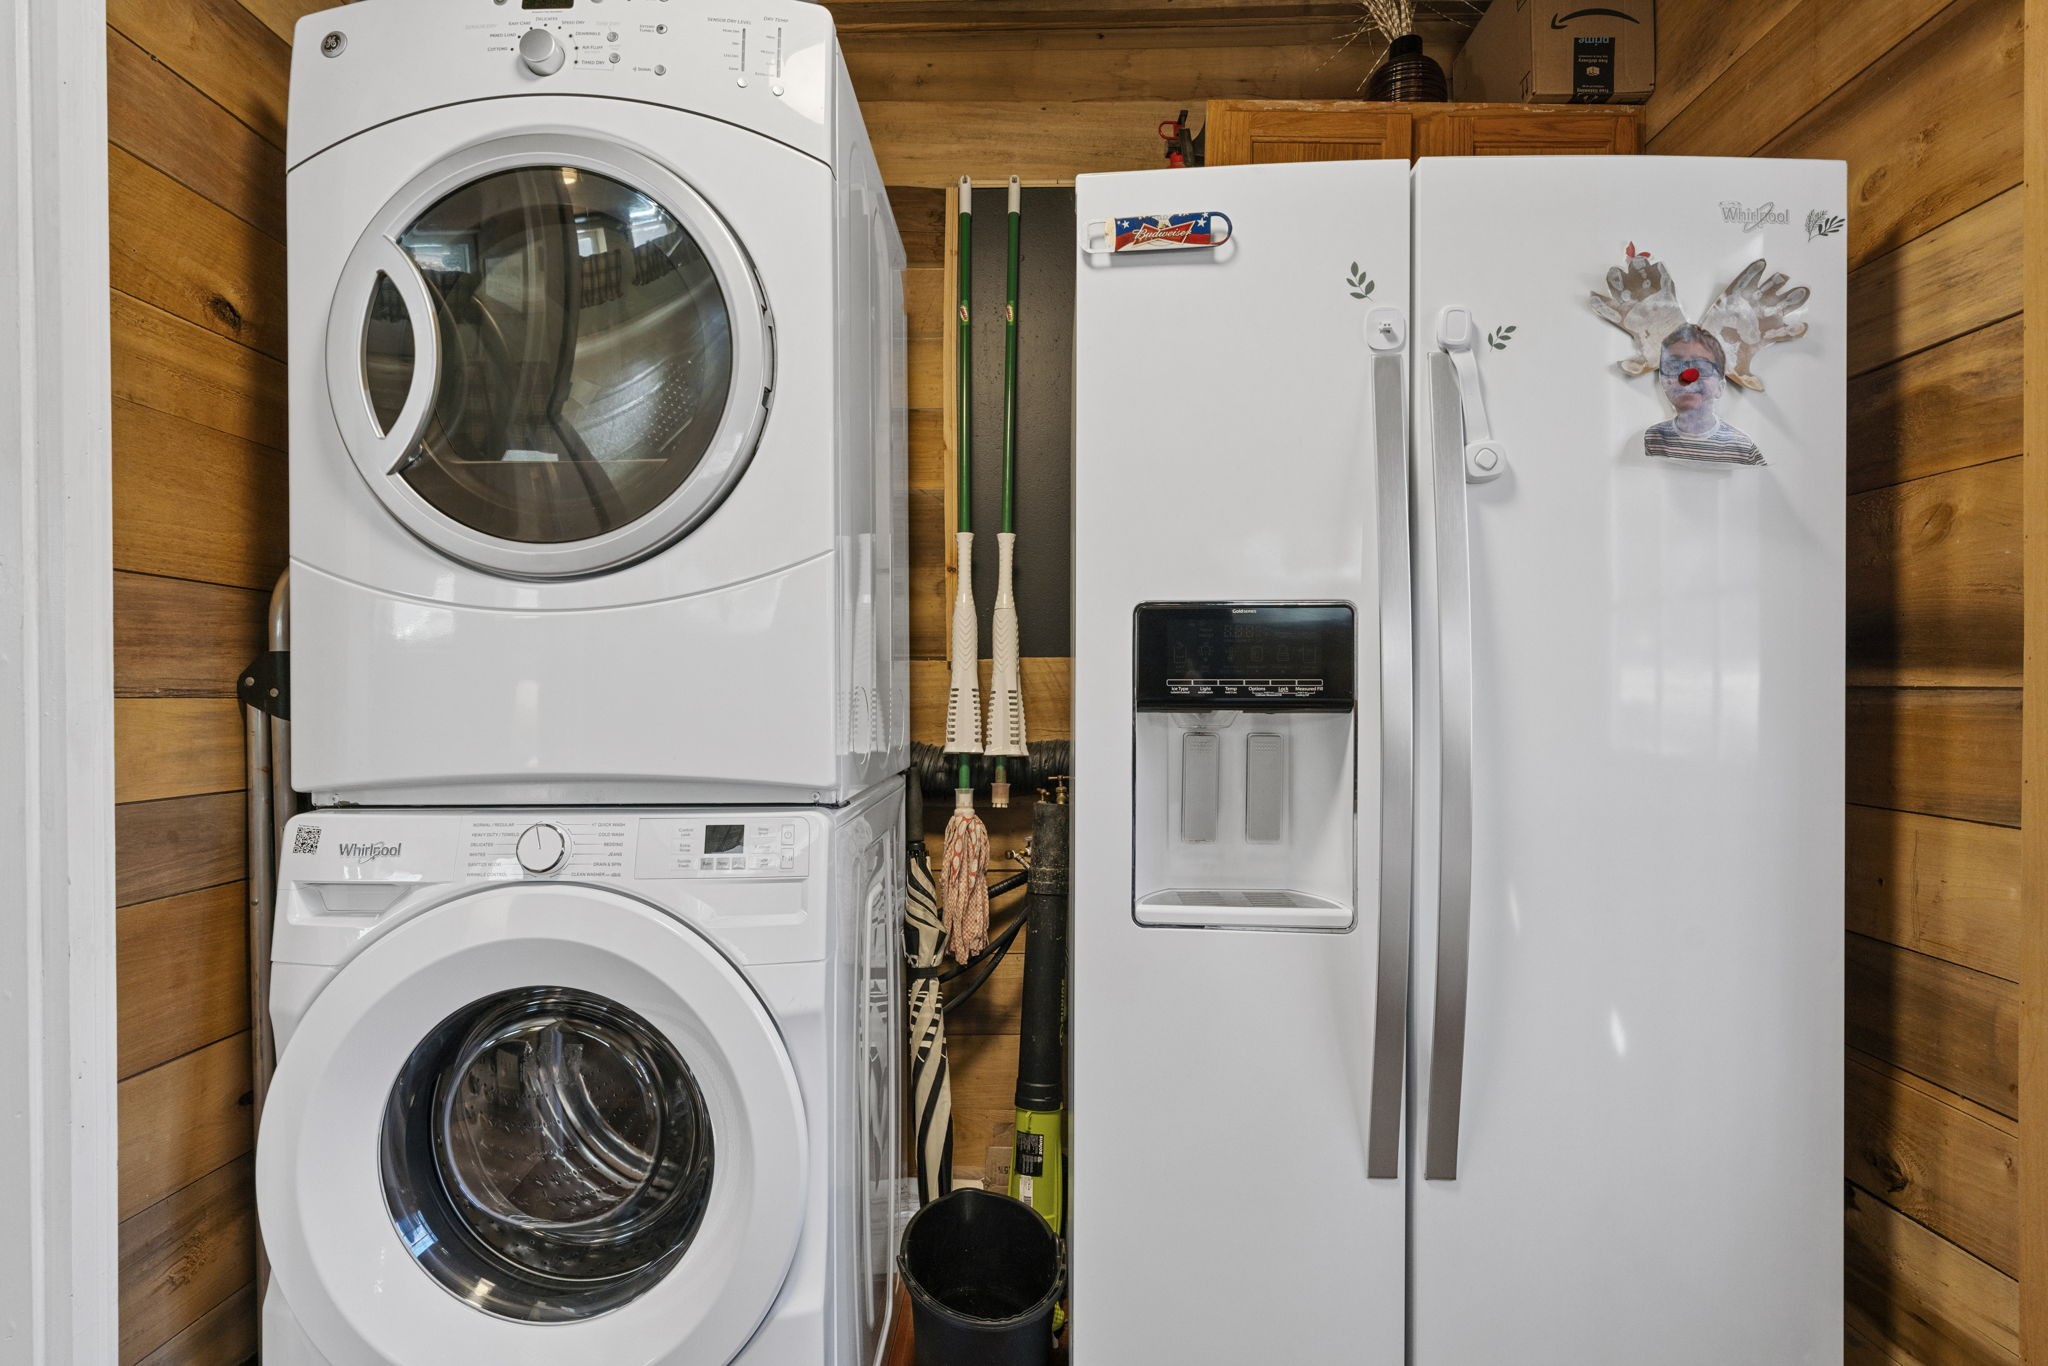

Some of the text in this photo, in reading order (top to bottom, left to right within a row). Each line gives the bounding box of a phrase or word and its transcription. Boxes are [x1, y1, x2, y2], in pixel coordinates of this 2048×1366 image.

[1721, 207, 1790, 227] Whirlpool
[1132, 229, 1192, 240] Budweiser
[339, 842, 402, 861] Whirlpool
